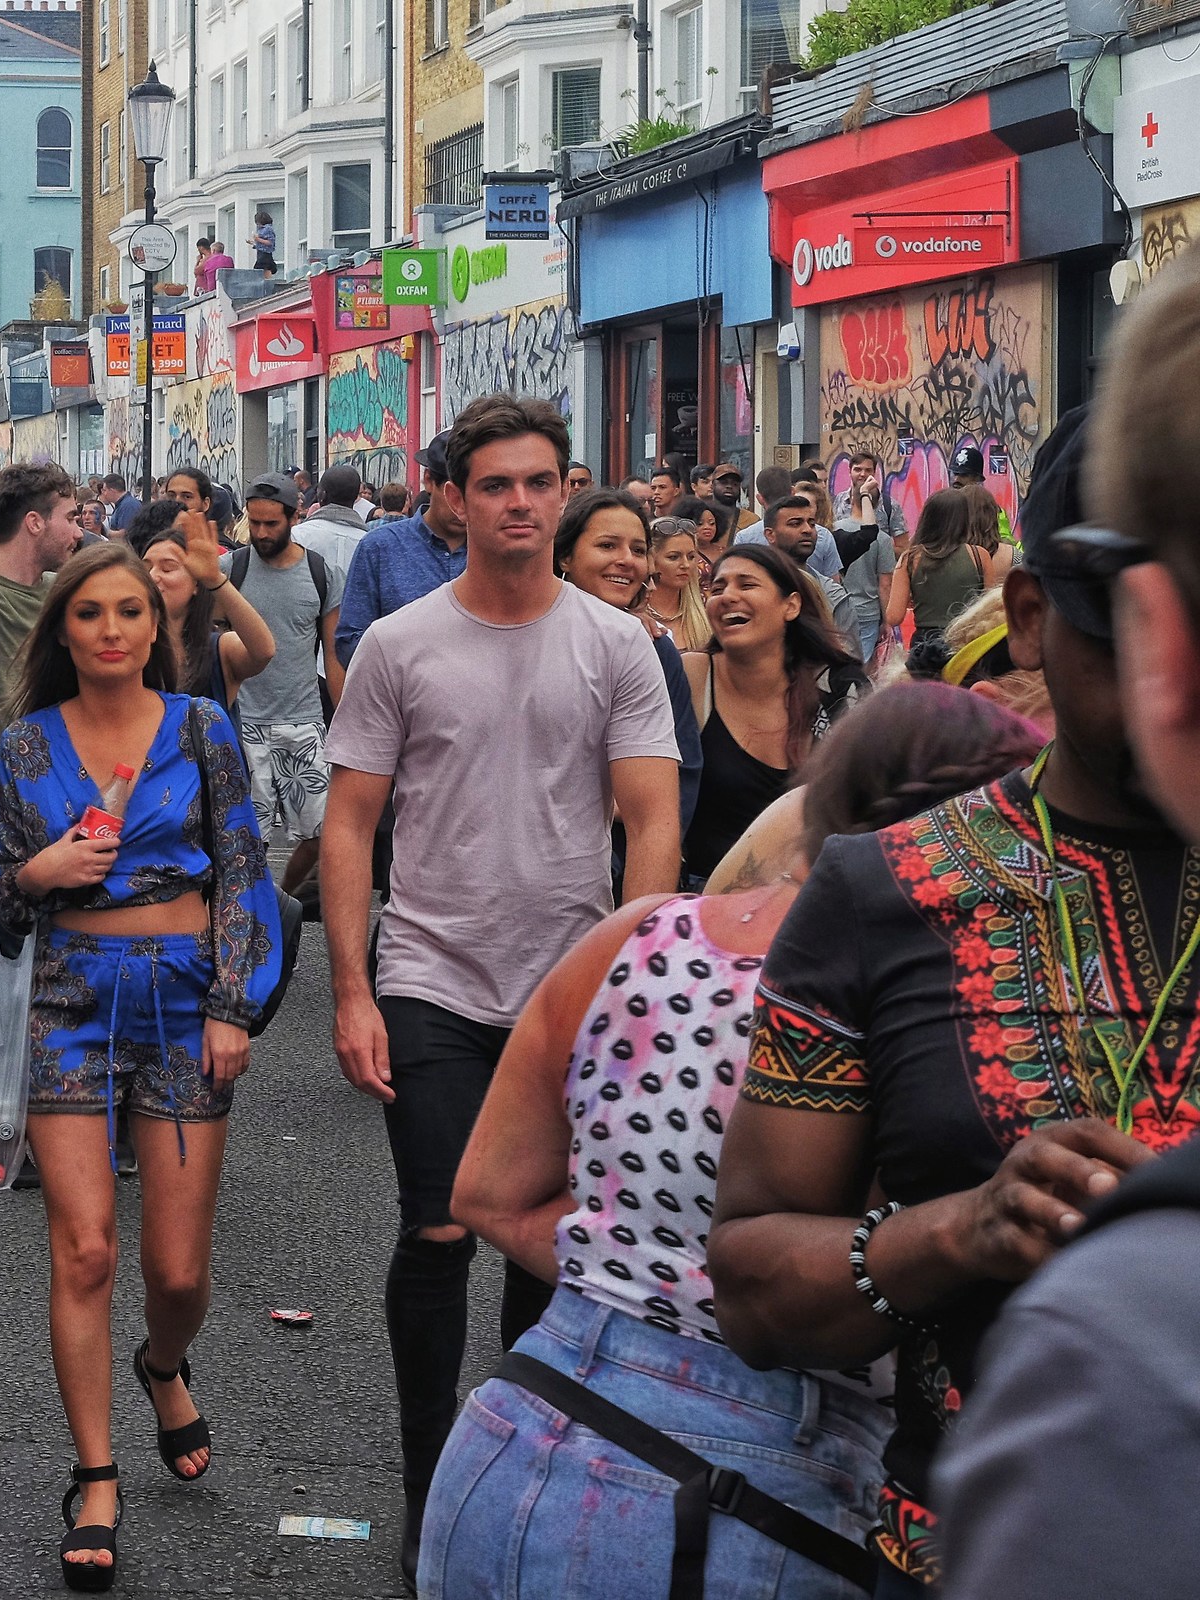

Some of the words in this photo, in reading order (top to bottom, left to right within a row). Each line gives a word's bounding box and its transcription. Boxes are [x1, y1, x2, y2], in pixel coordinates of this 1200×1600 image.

[1141, 157, 1160, 169] British
[1136, 170, 1164, 182] RedCross
[595, 191, 608, 207] THE
[610, 180, 639, 201] ITALIAN
[642, 168, 672, 190] COFFEE
[499, 194, 537, 205] CAFFÈ
[489, 209, 547, 223] NERO
[902, 236, 982, 252] vodafone
[396, 285, 428, 296] OXFAM
[110, 361, 129, 370] 020
[158, 359, 183, 369] 3990
[667, 392, 686, 402] FREE
